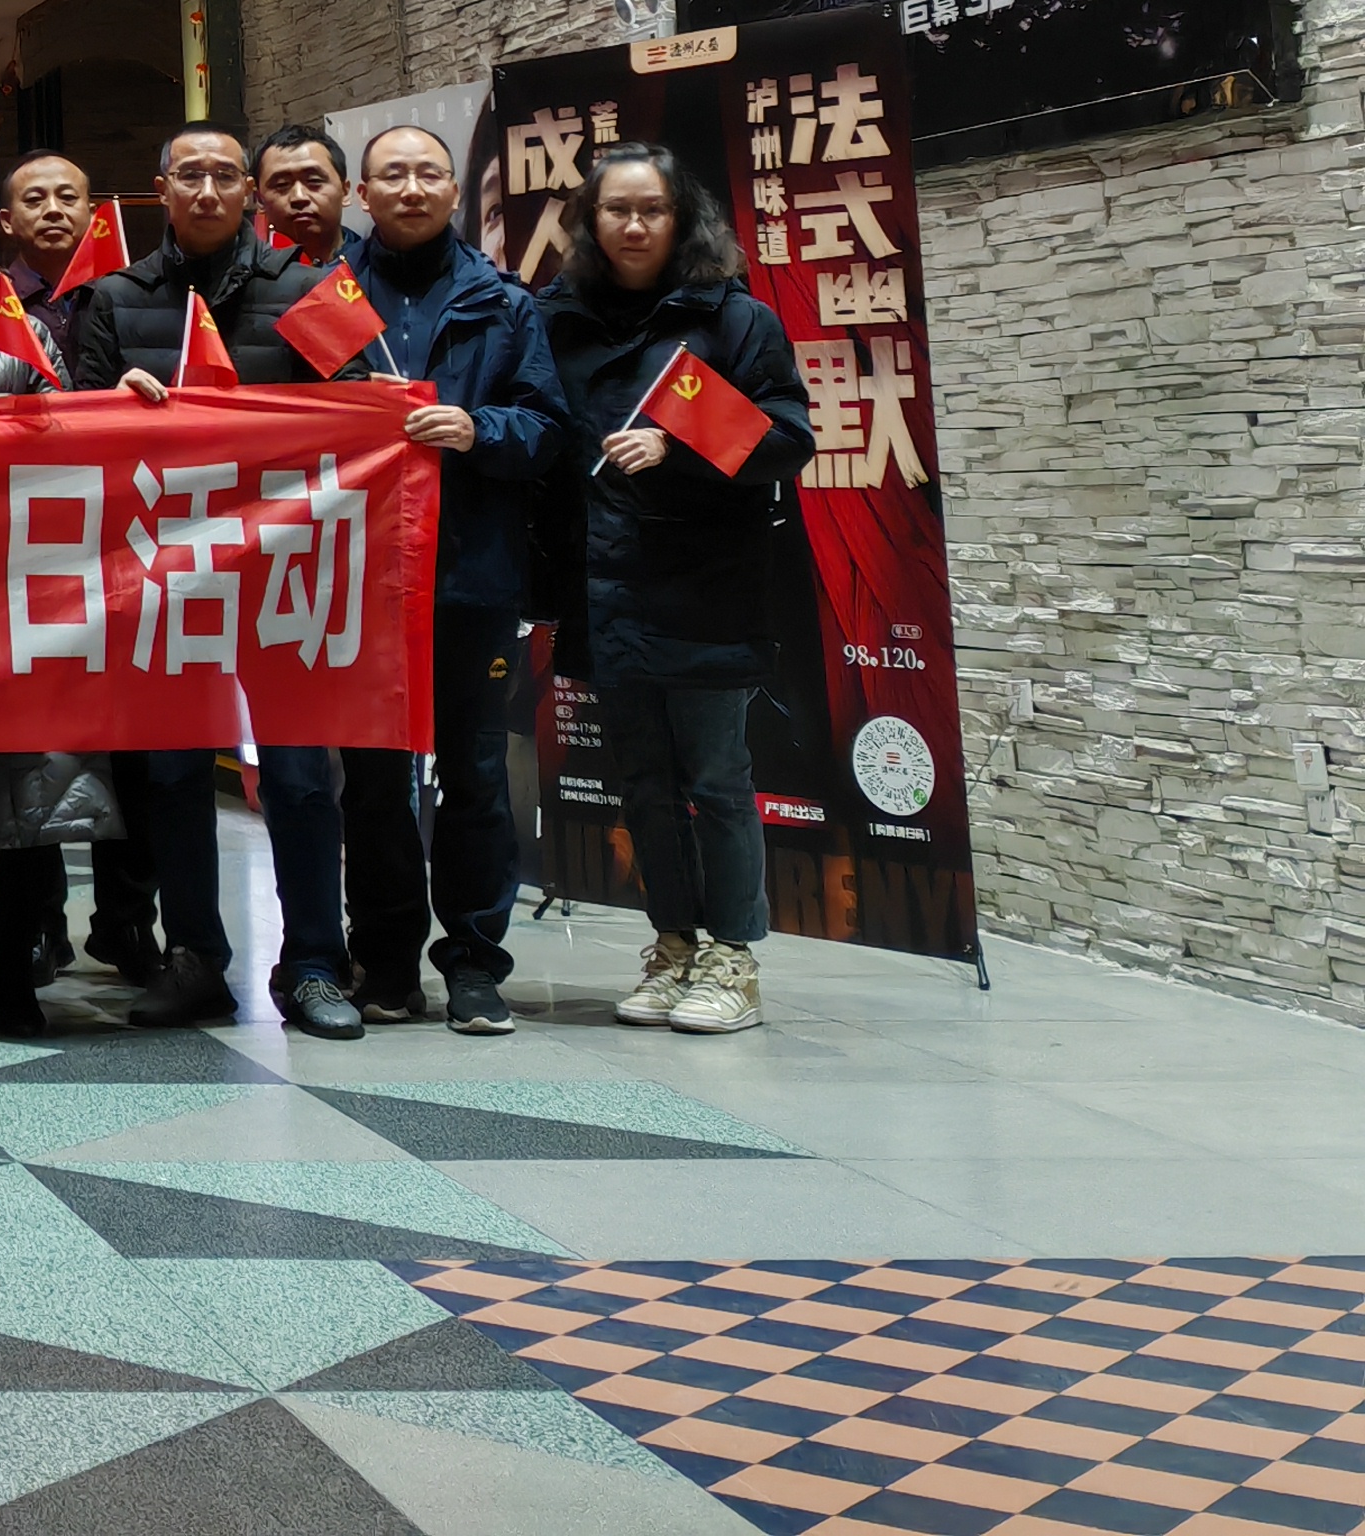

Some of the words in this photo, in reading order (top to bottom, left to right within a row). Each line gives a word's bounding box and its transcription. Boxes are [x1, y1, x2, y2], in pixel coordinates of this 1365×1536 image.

[746, 77, 791, 265] 泸州味道
[758, 64, 929, 490] 法式幽默
